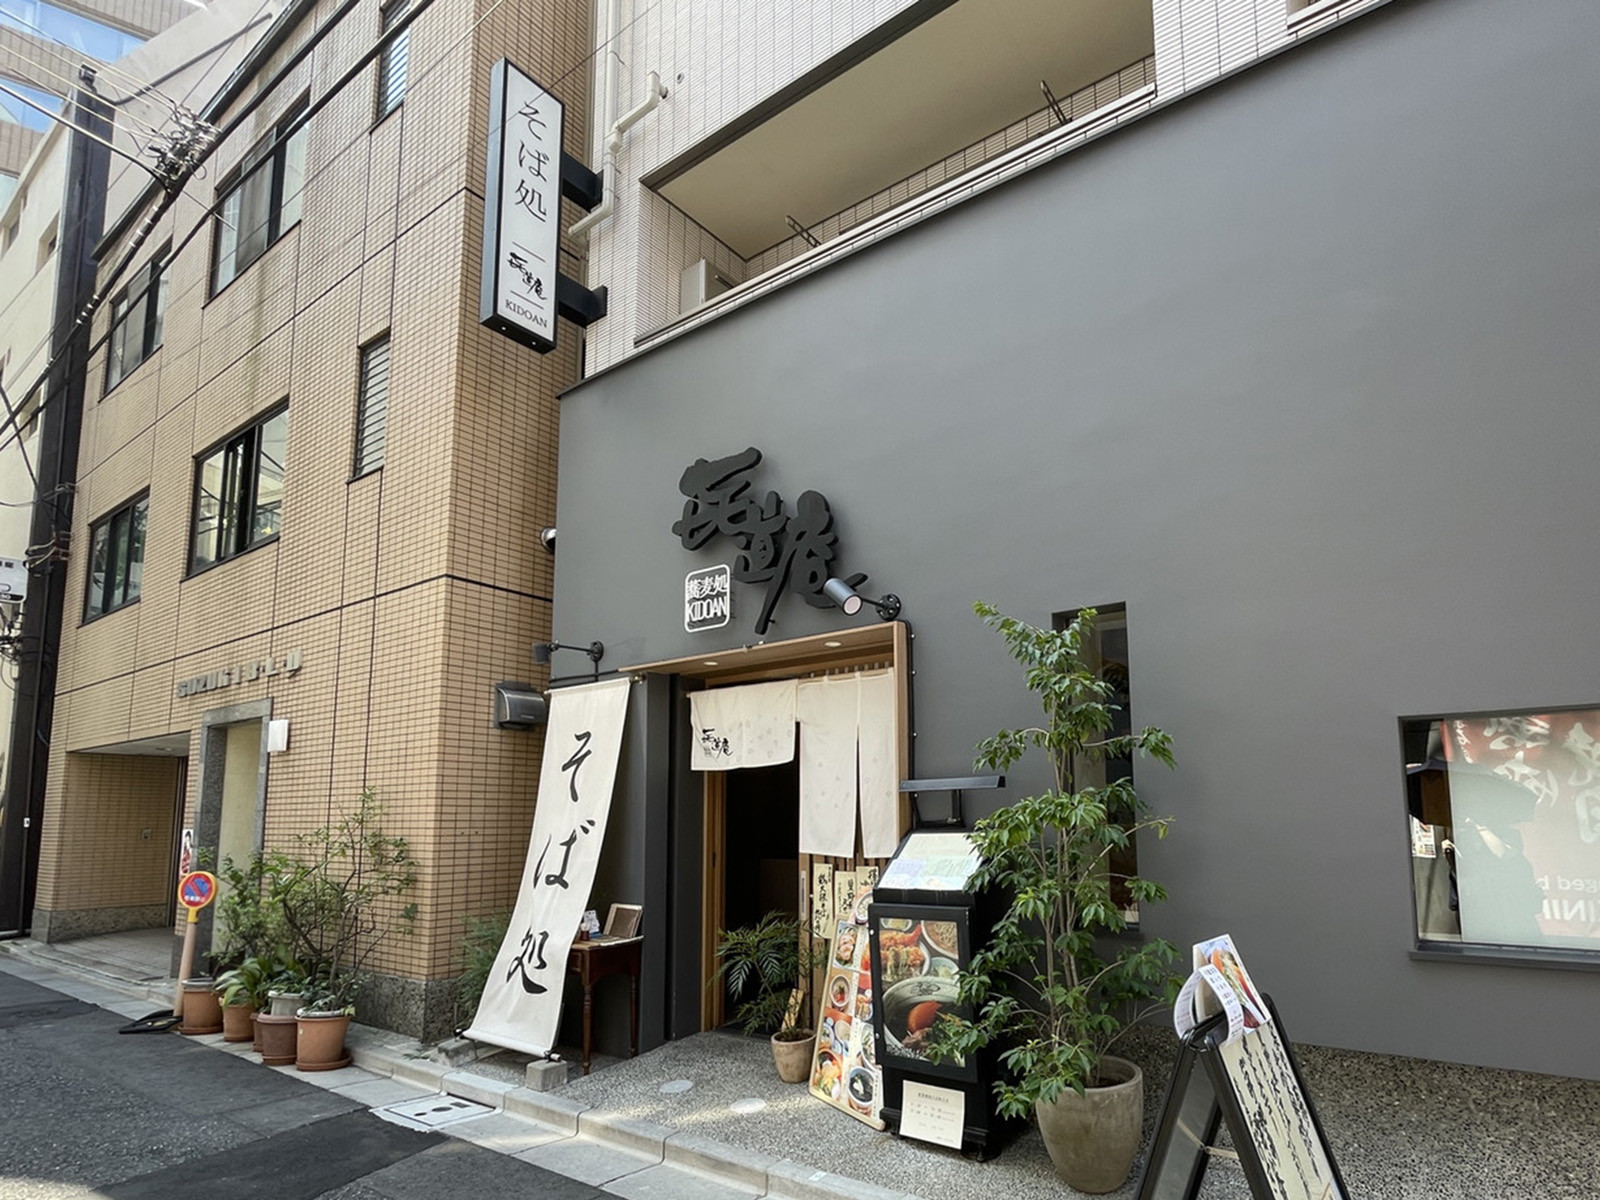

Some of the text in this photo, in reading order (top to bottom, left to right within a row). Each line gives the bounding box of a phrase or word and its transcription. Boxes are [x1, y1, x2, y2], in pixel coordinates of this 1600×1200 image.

[515, 101, 549, 223] そば処
[505, 299, 547, 329] KIDOAN
[687, 595, 728, 622] KIDOAN
[506, 730, 595, 995] そば処
